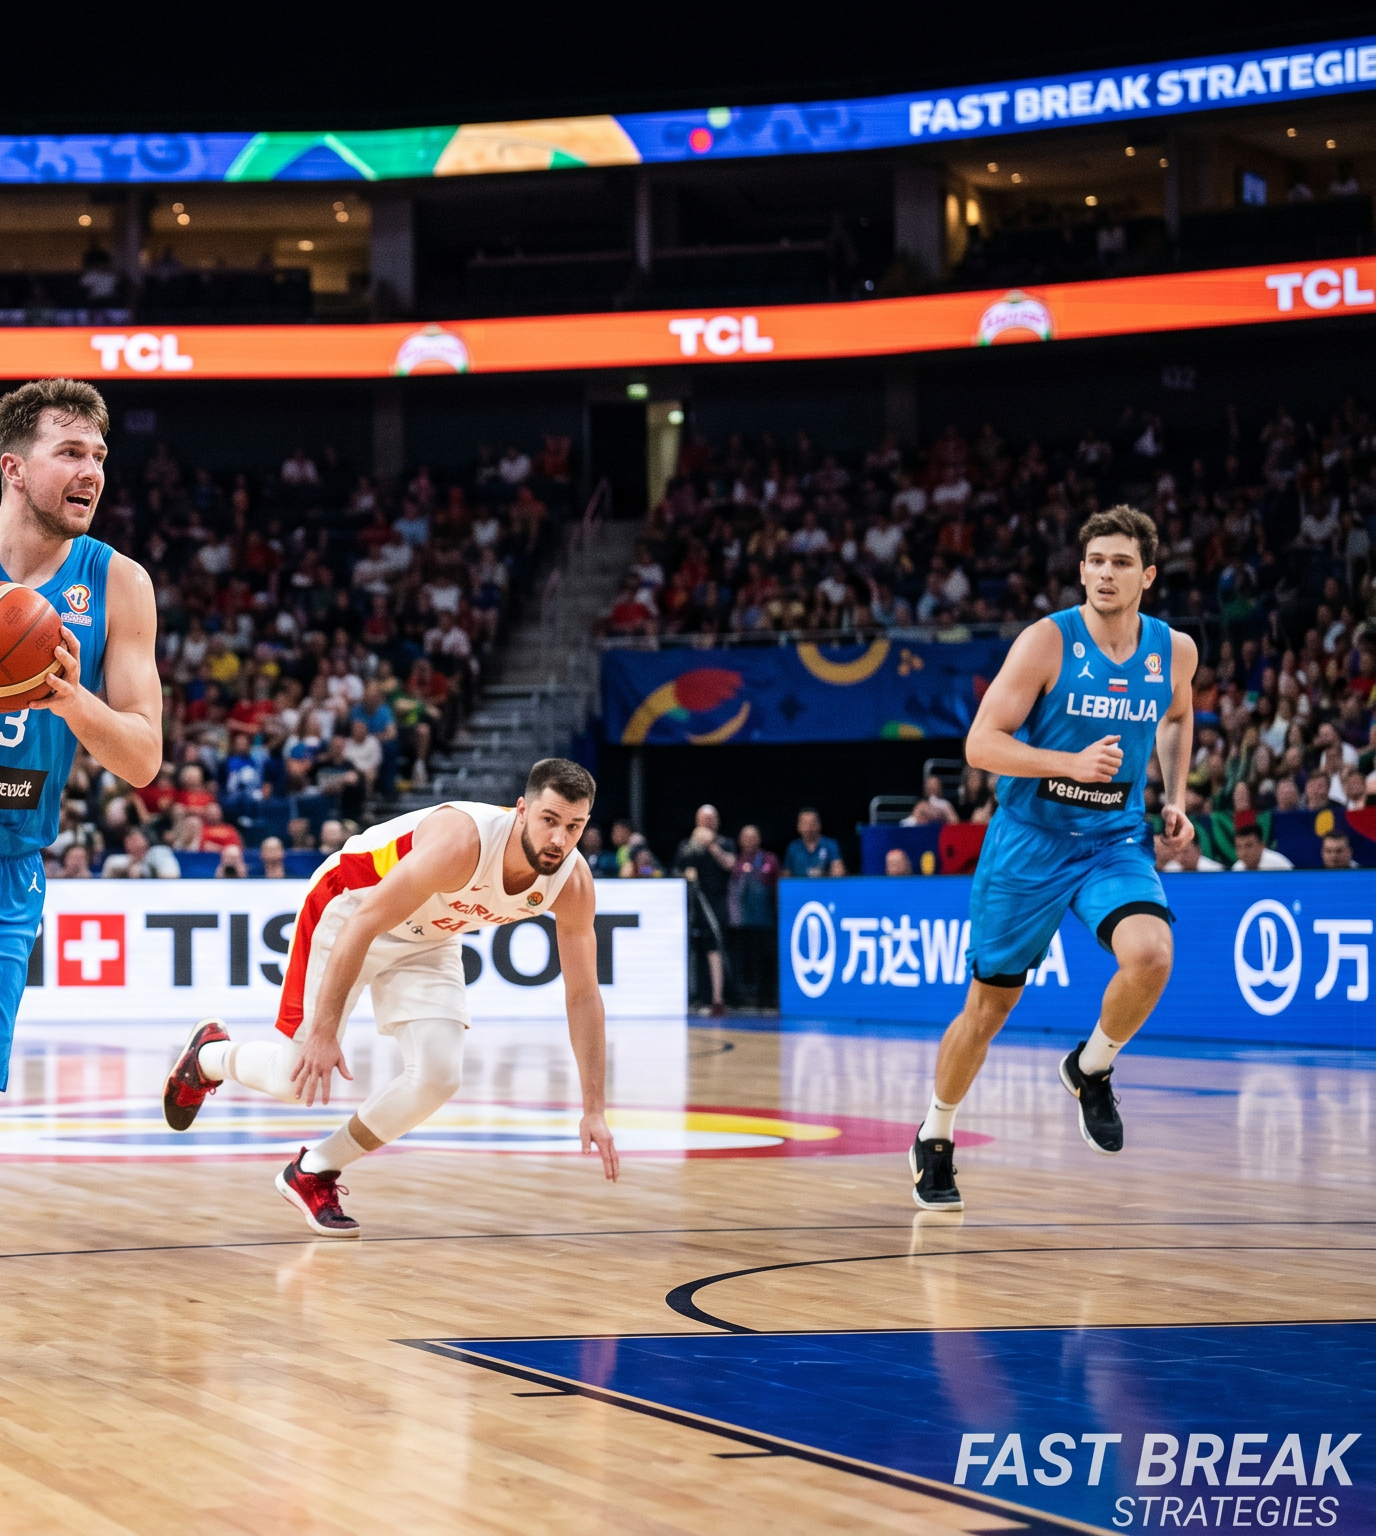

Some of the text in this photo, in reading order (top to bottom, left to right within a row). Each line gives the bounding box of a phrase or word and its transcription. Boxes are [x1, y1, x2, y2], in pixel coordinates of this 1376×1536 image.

[909, 45, 1376, 136] FAST BREAK STRATEGIE
[1268, 269, 1375, 310] TCL
[91, 333, 193, 371] TCL
[669, 316, 774, 355] TCL
[840, 914, 920, 987] 万达
[1313, 919, 1374, 1002] 万
